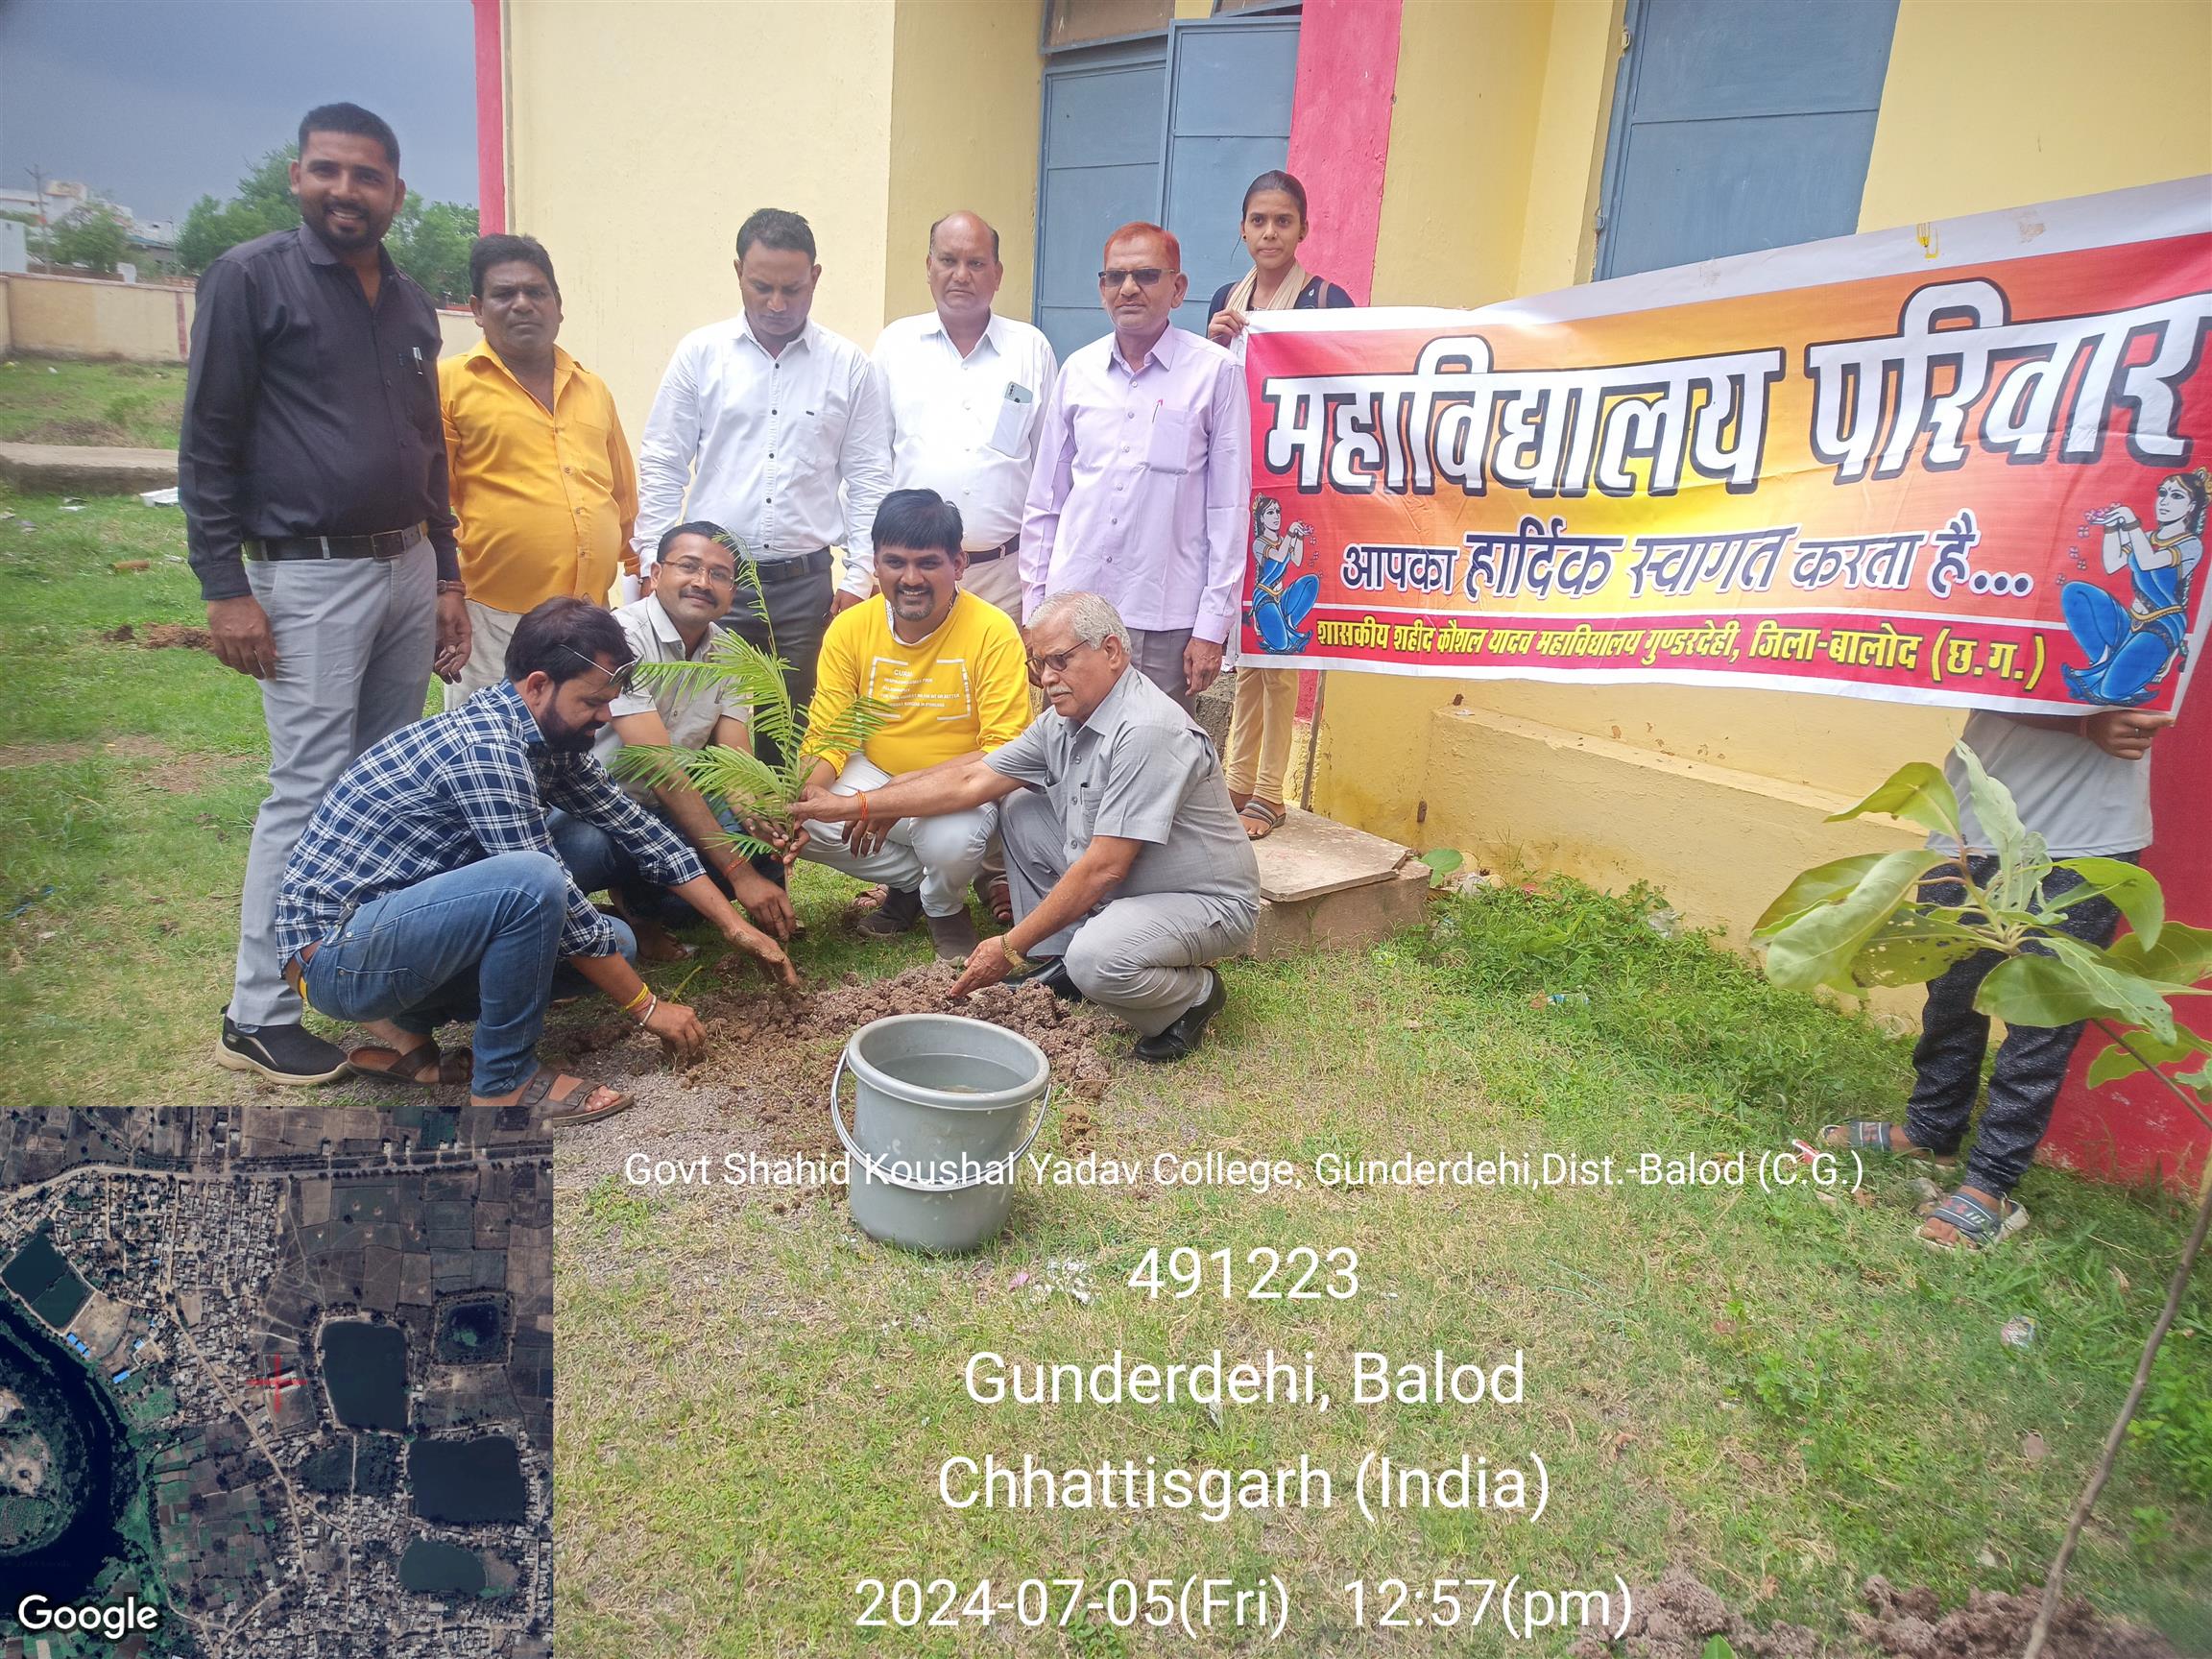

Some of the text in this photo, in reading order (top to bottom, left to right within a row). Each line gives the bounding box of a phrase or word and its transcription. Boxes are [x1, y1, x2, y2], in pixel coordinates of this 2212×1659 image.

[1263, 276, 2212, 497] महाविद्यालय परिवार
[1342, 544, 1459, 592] आपका
[1465, 515, 1626, 601] हार्दिक
[1628, 523, 1801, 597] स्वागत
[1791, 532, 1928, 591] करता
[1316, 615, 1389, 650] शासकीय
[1393, 619, 1436, 654] शहीद
[1437, 618, 1488, 654] कौशल
[1488, 629, 1538, 656] यादव
[1537, 624, 1646, 659] महाविद्यालय
[1931, 627, 2047, 692] (छ.ग.)
